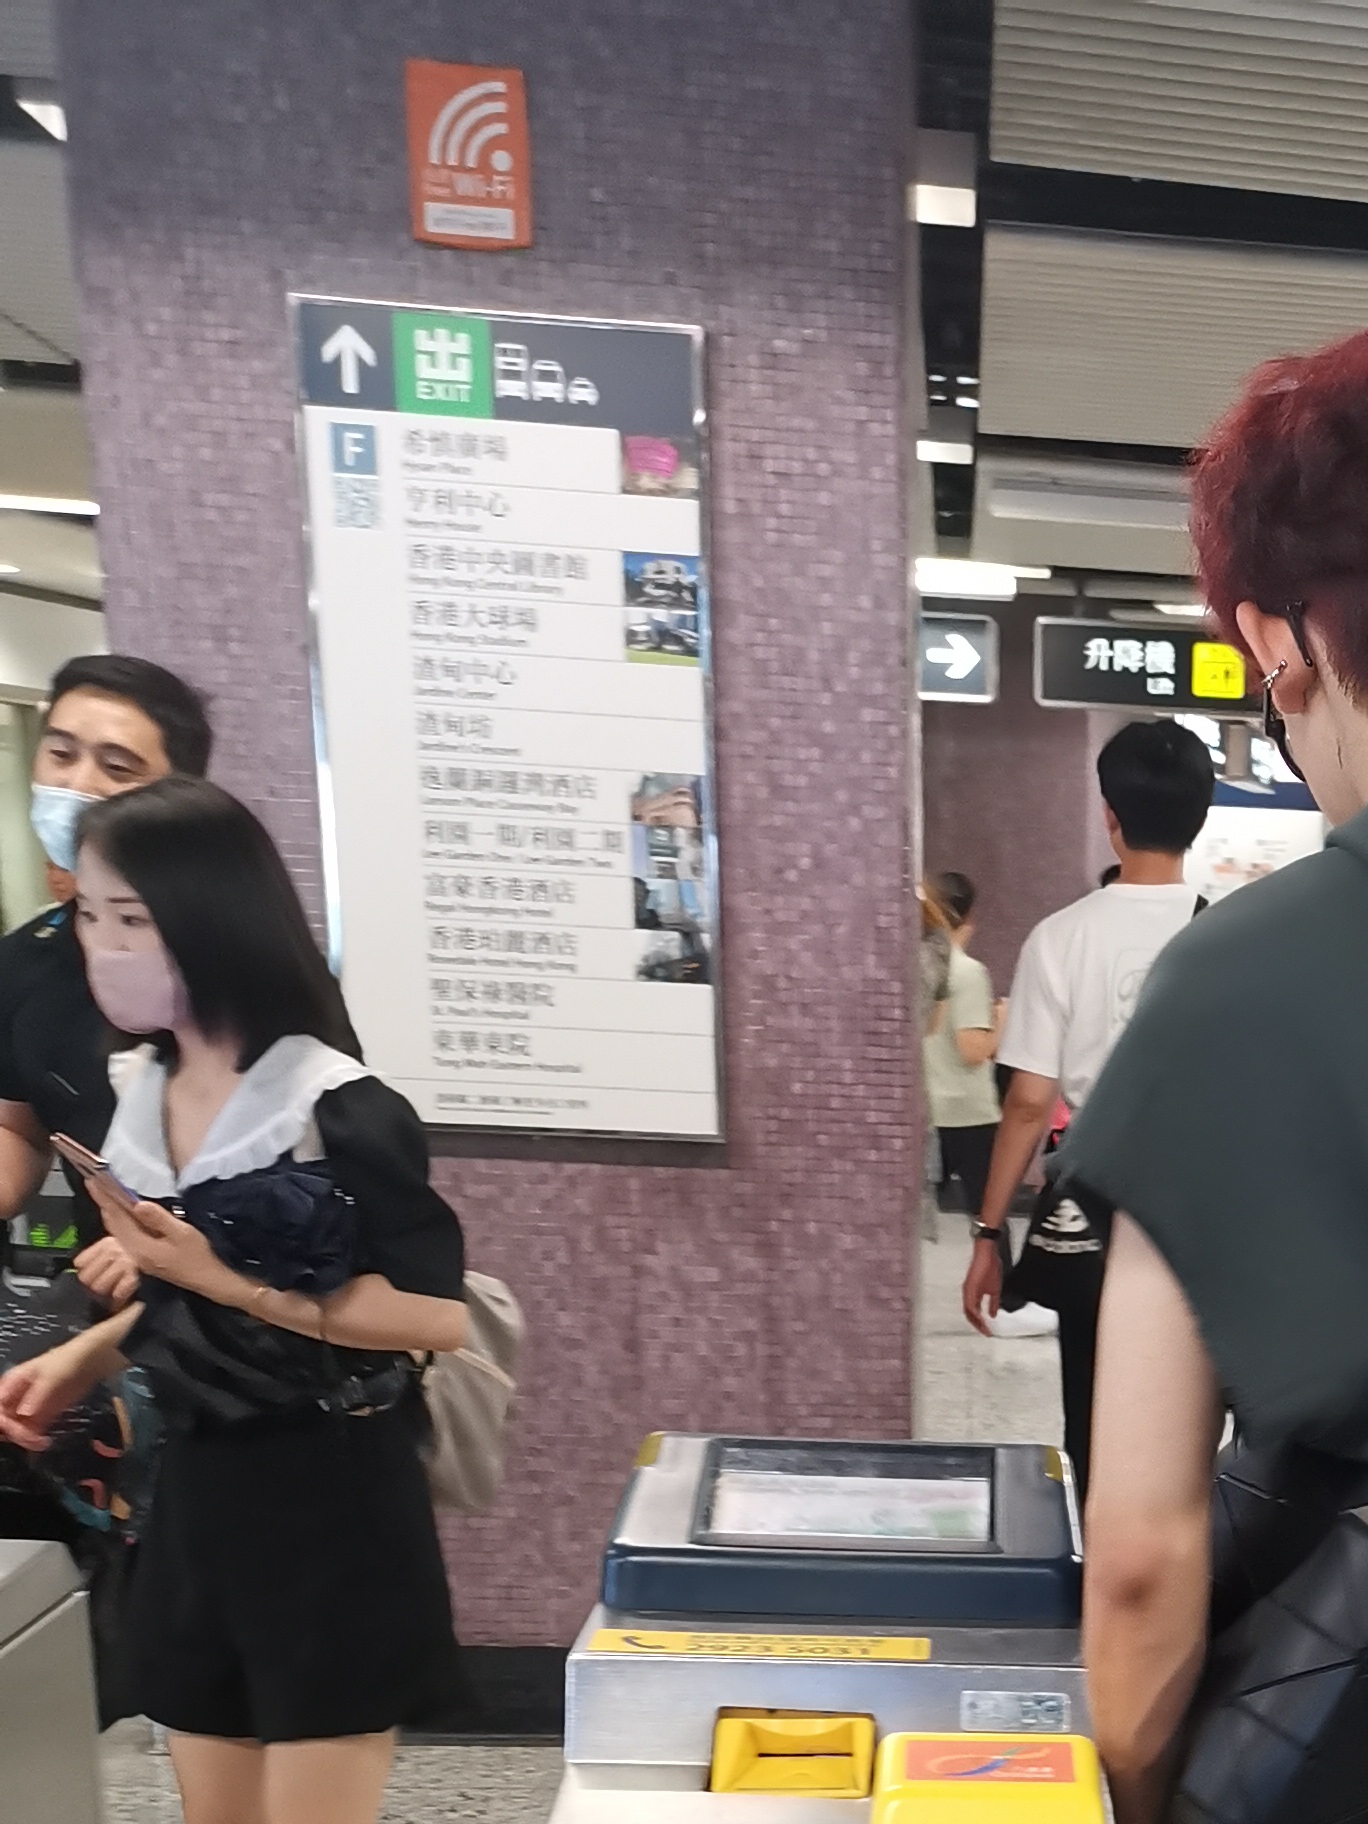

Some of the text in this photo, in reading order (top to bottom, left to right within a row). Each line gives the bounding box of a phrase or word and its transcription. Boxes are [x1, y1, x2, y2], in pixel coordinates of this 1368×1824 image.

[414, 328, 473, 381] 出
[416, 380, 472, 402] EXIT
[343, 432, 366, 466] F
[406, 485, 511, 518] 亨利中心
[410, 544, 588, 580] 香港中央圖書館
[412, 599, 537, 632] 香港大球場
[687, 1643, 872, 1657] 2923 5031
